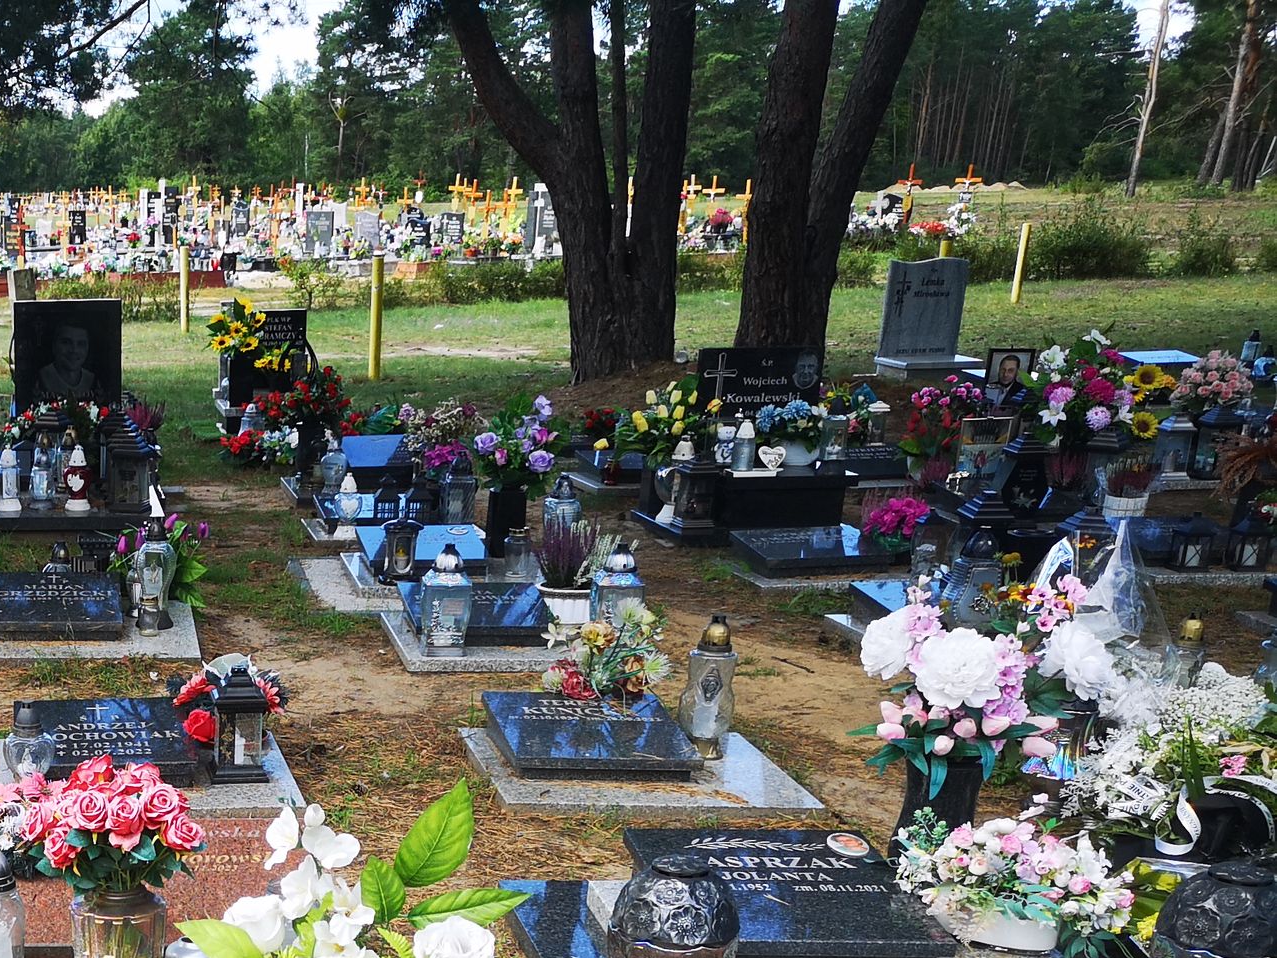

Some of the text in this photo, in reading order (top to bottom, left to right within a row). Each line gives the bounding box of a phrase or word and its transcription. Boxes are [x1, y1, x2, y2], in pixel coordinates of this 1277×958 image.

[743, 376, 788, 388] Wojciech
[726, 392, 801, 404] Kowalewski
[539, 700, 603, 708] TERES
[54, 721, 147, 731] ANDRZEJ
[52, 731, 181, 741] OCHOWIAK
[71, 748, 153, 757] 02.07.2022
[707, 856, 858, 870] ASPRZAK
[721, 871, 835, 882] JOLANTA
[820, 884, 889, 893] 08.11.2021
